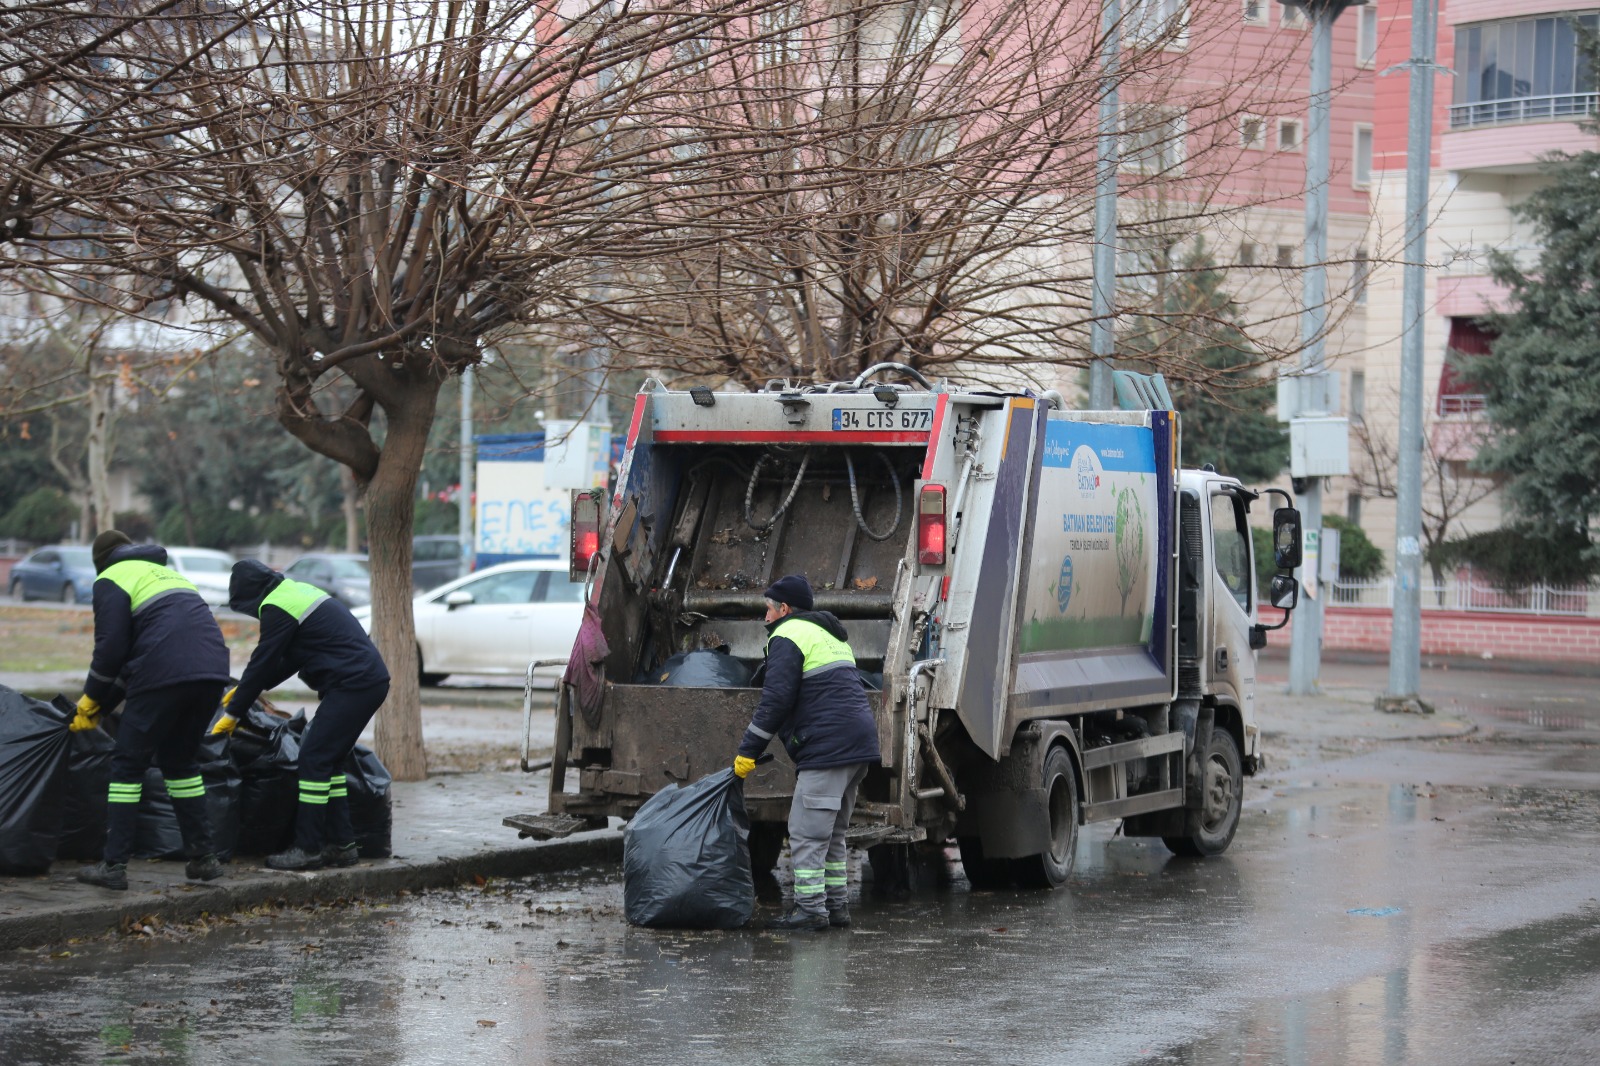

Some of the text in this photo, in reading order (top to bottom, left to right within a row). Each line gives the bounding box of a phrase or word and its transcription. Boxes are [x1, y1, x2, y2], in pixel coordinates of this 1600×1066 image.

[842, 411, 929, 428] 34 CTS 677
[1063, 511, 1116, 533] BATMAN BELEDİYESİ
